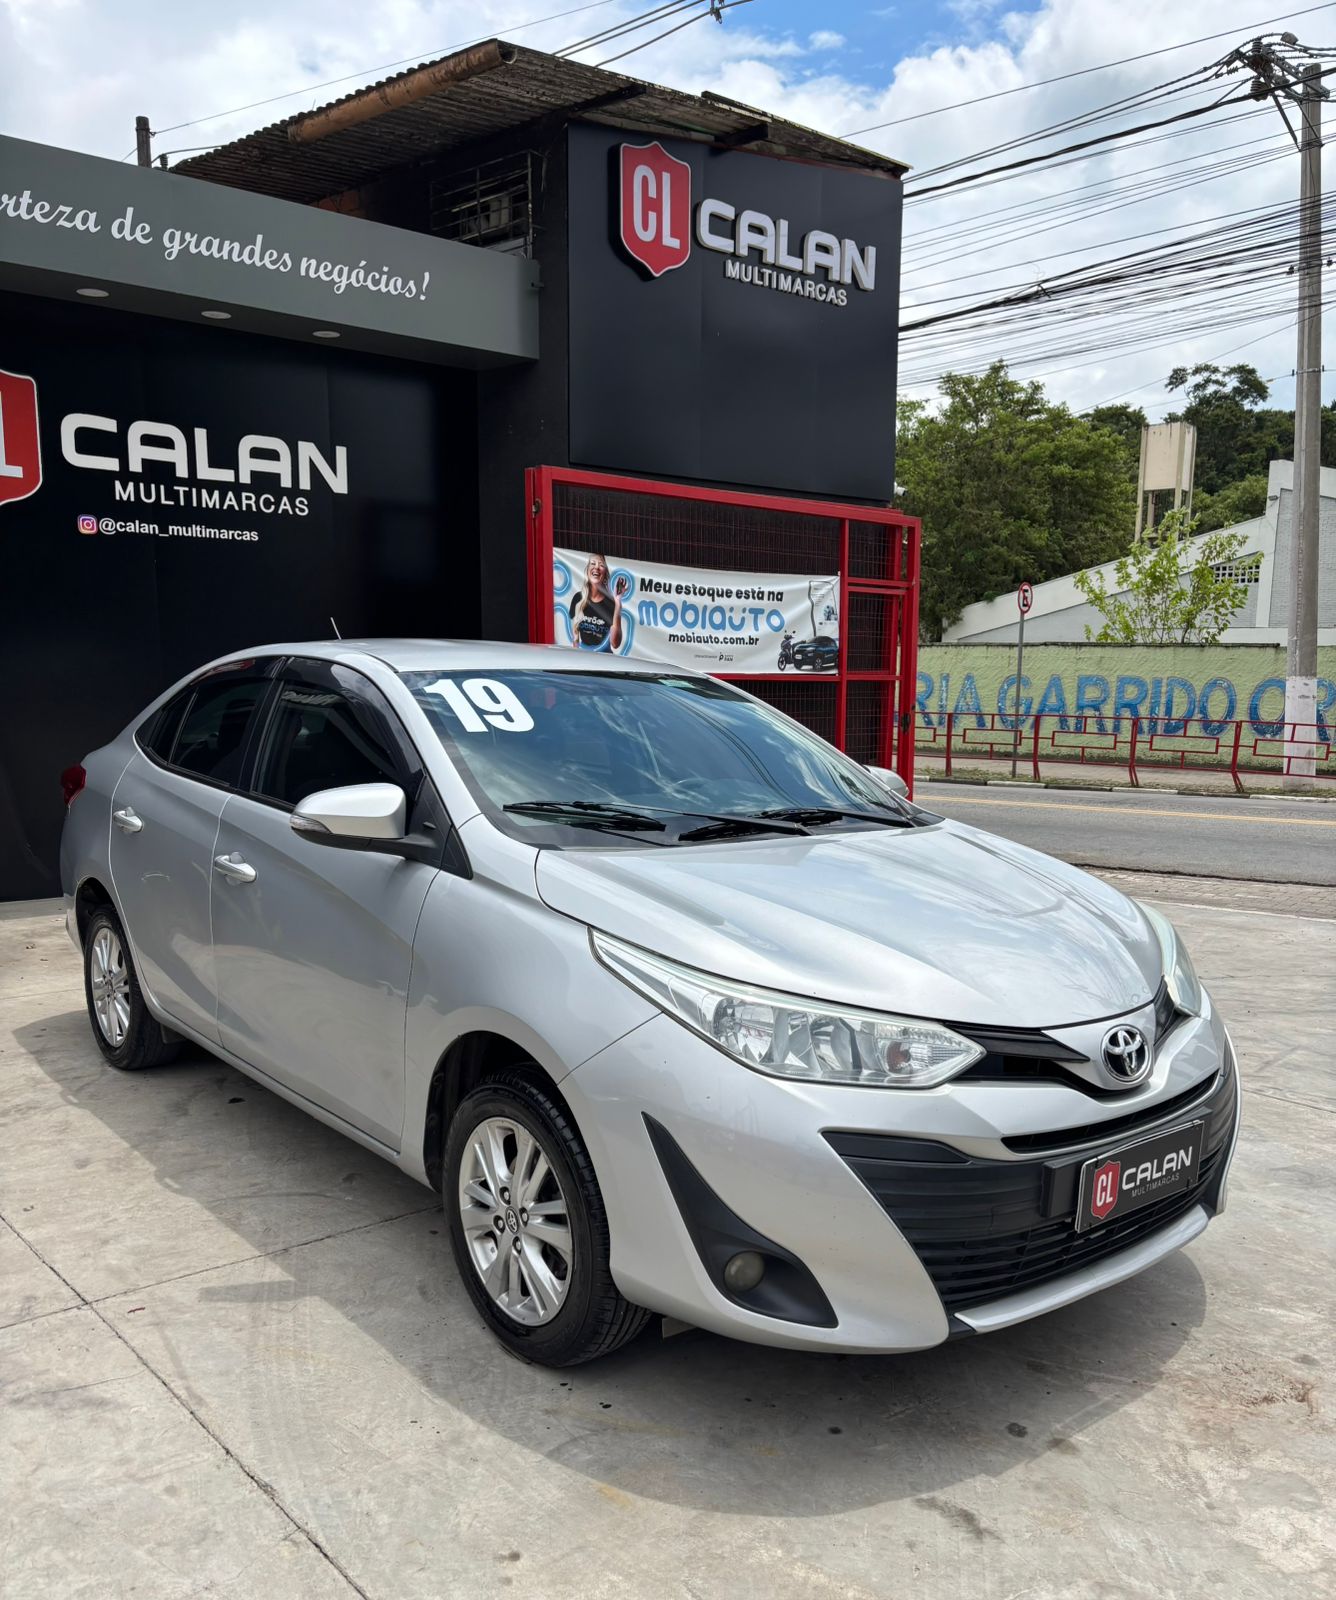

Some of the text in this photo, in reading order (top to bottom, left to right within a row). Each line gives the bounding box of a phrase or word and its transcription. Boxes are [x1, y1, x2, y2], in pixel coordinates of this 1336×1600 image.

[633, 164, 681, 250] CL
[111, 206, 153, 244] de
[162, 229, 292, 272] grandes
[299, 256, 431, 301] negócios!
[697, 198, 876, 291] CALAN
[725, 259, 848, 306] MULTIMARCAS
[60, 412, 348, 495] CALAN
[114, 480, 310, 516] MULTIMARCAS
[99, 517, 259, 542] @calan_multimarcas
[639, 577, 784, 603] Meu estoque está na
[668, 632, 760, 646] mobiauto.com.br
[423, 678, 535, 733] 19
[894, 671, 987, 728] RIA
[997, 673, 1237, 737] GARRIDO
[1096, 1171, 1114, 1207] CL
[1122, 1146, 1193, 1191] CALAN
[1131, 1172, 1180, 1198] MULTIMARCAS
